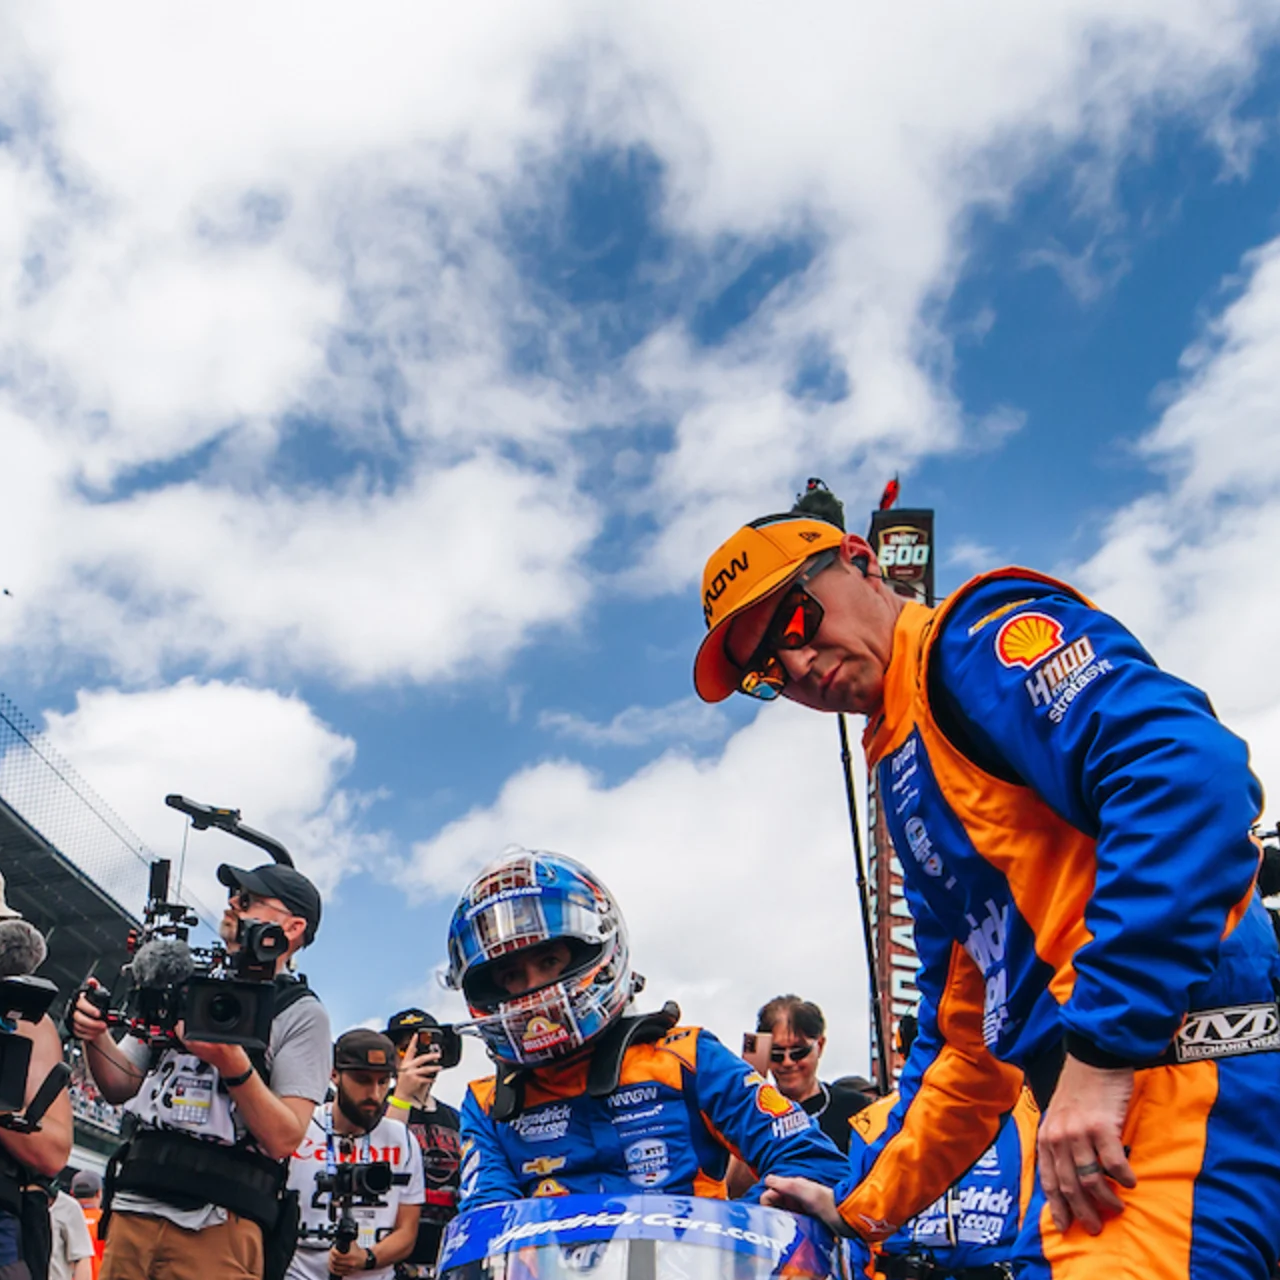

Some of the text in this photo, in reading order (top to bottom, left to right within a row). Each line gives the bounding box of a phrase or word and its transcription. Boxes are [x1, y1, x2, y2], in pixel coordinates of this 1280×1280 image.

[888, 534, 918, 544] INDY
[879, 544, 929, 565] 500
[1181, 1040, 1249, 1058] MECHANIX
